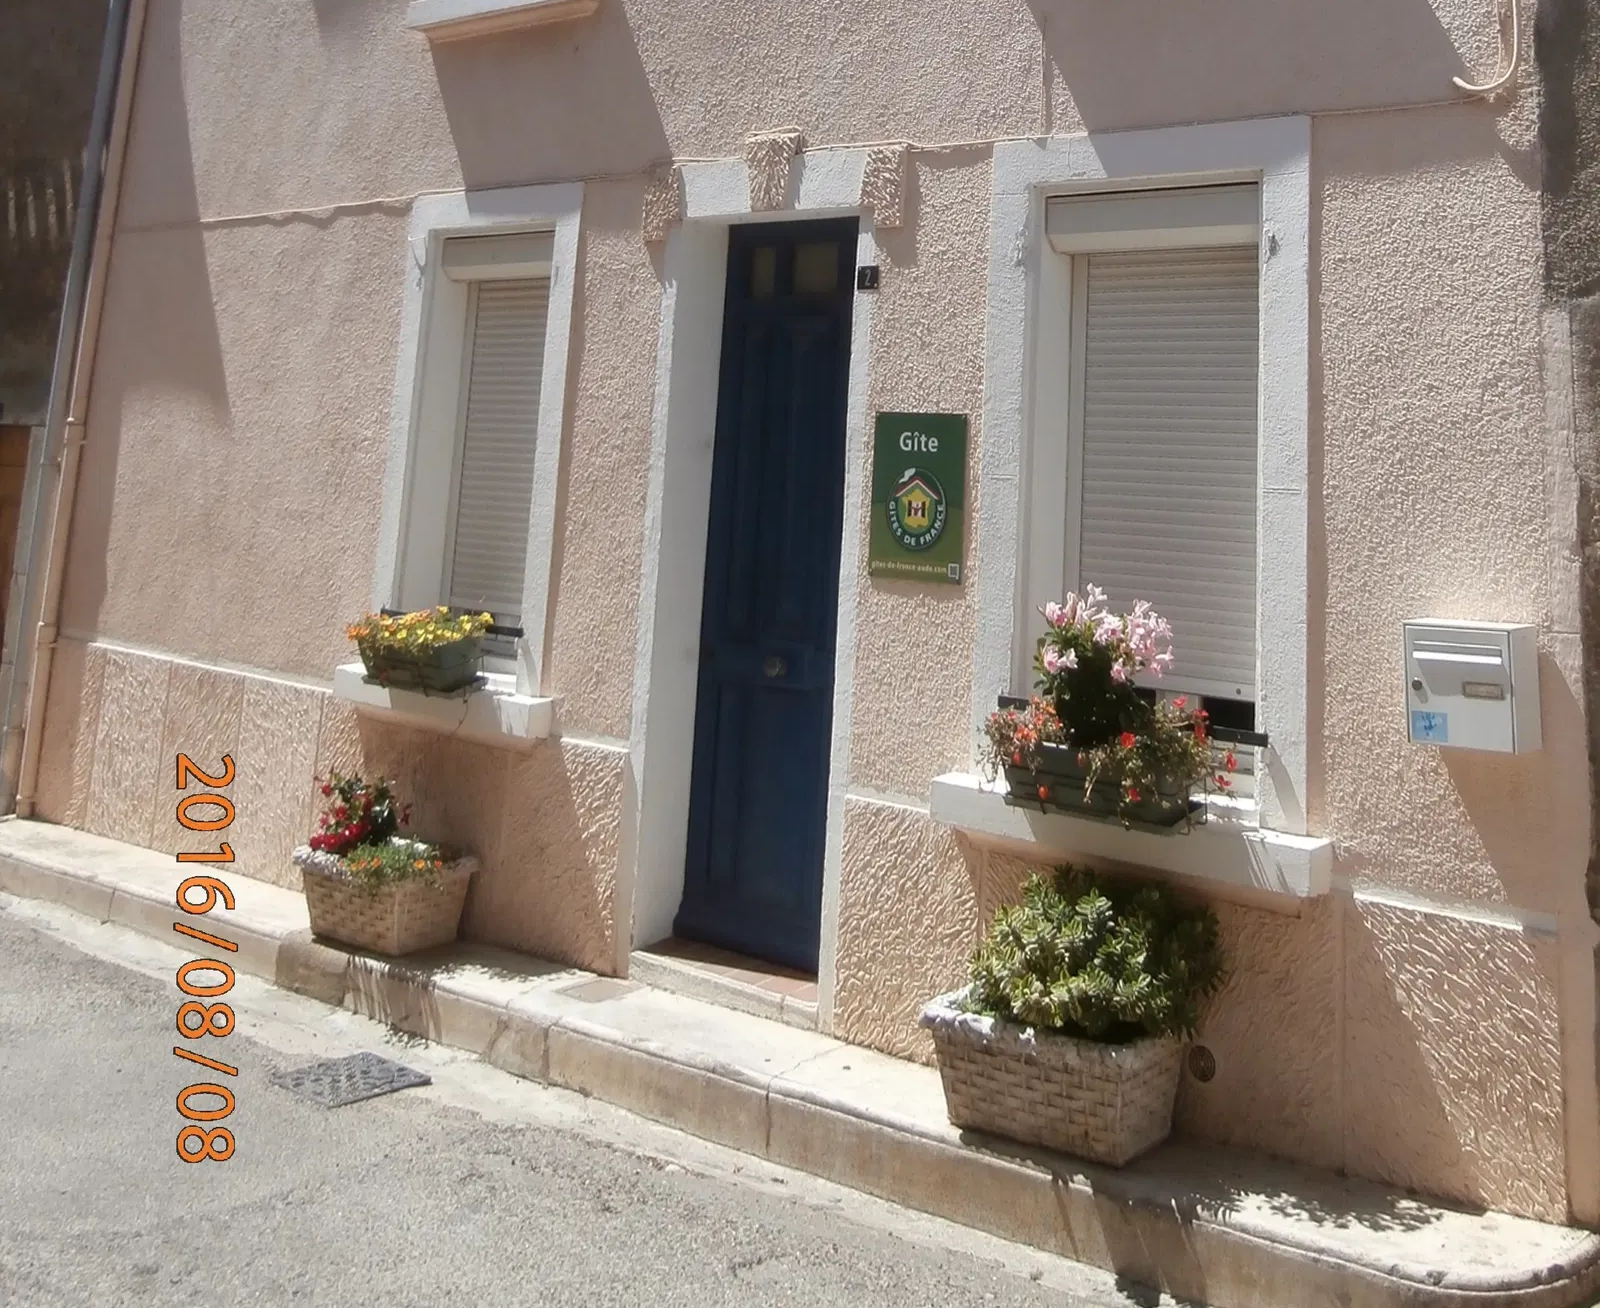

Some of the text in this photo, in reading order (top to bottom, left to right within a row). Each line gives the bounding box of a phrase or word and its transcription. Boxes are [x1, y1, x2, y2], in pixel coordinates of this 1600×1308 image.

[865, 269, 872, 286] 2
[899, 431, 939, 452] Gîte
[903, 535, 916, 546] DE
[919, 504, 944, 545] FRANCE
